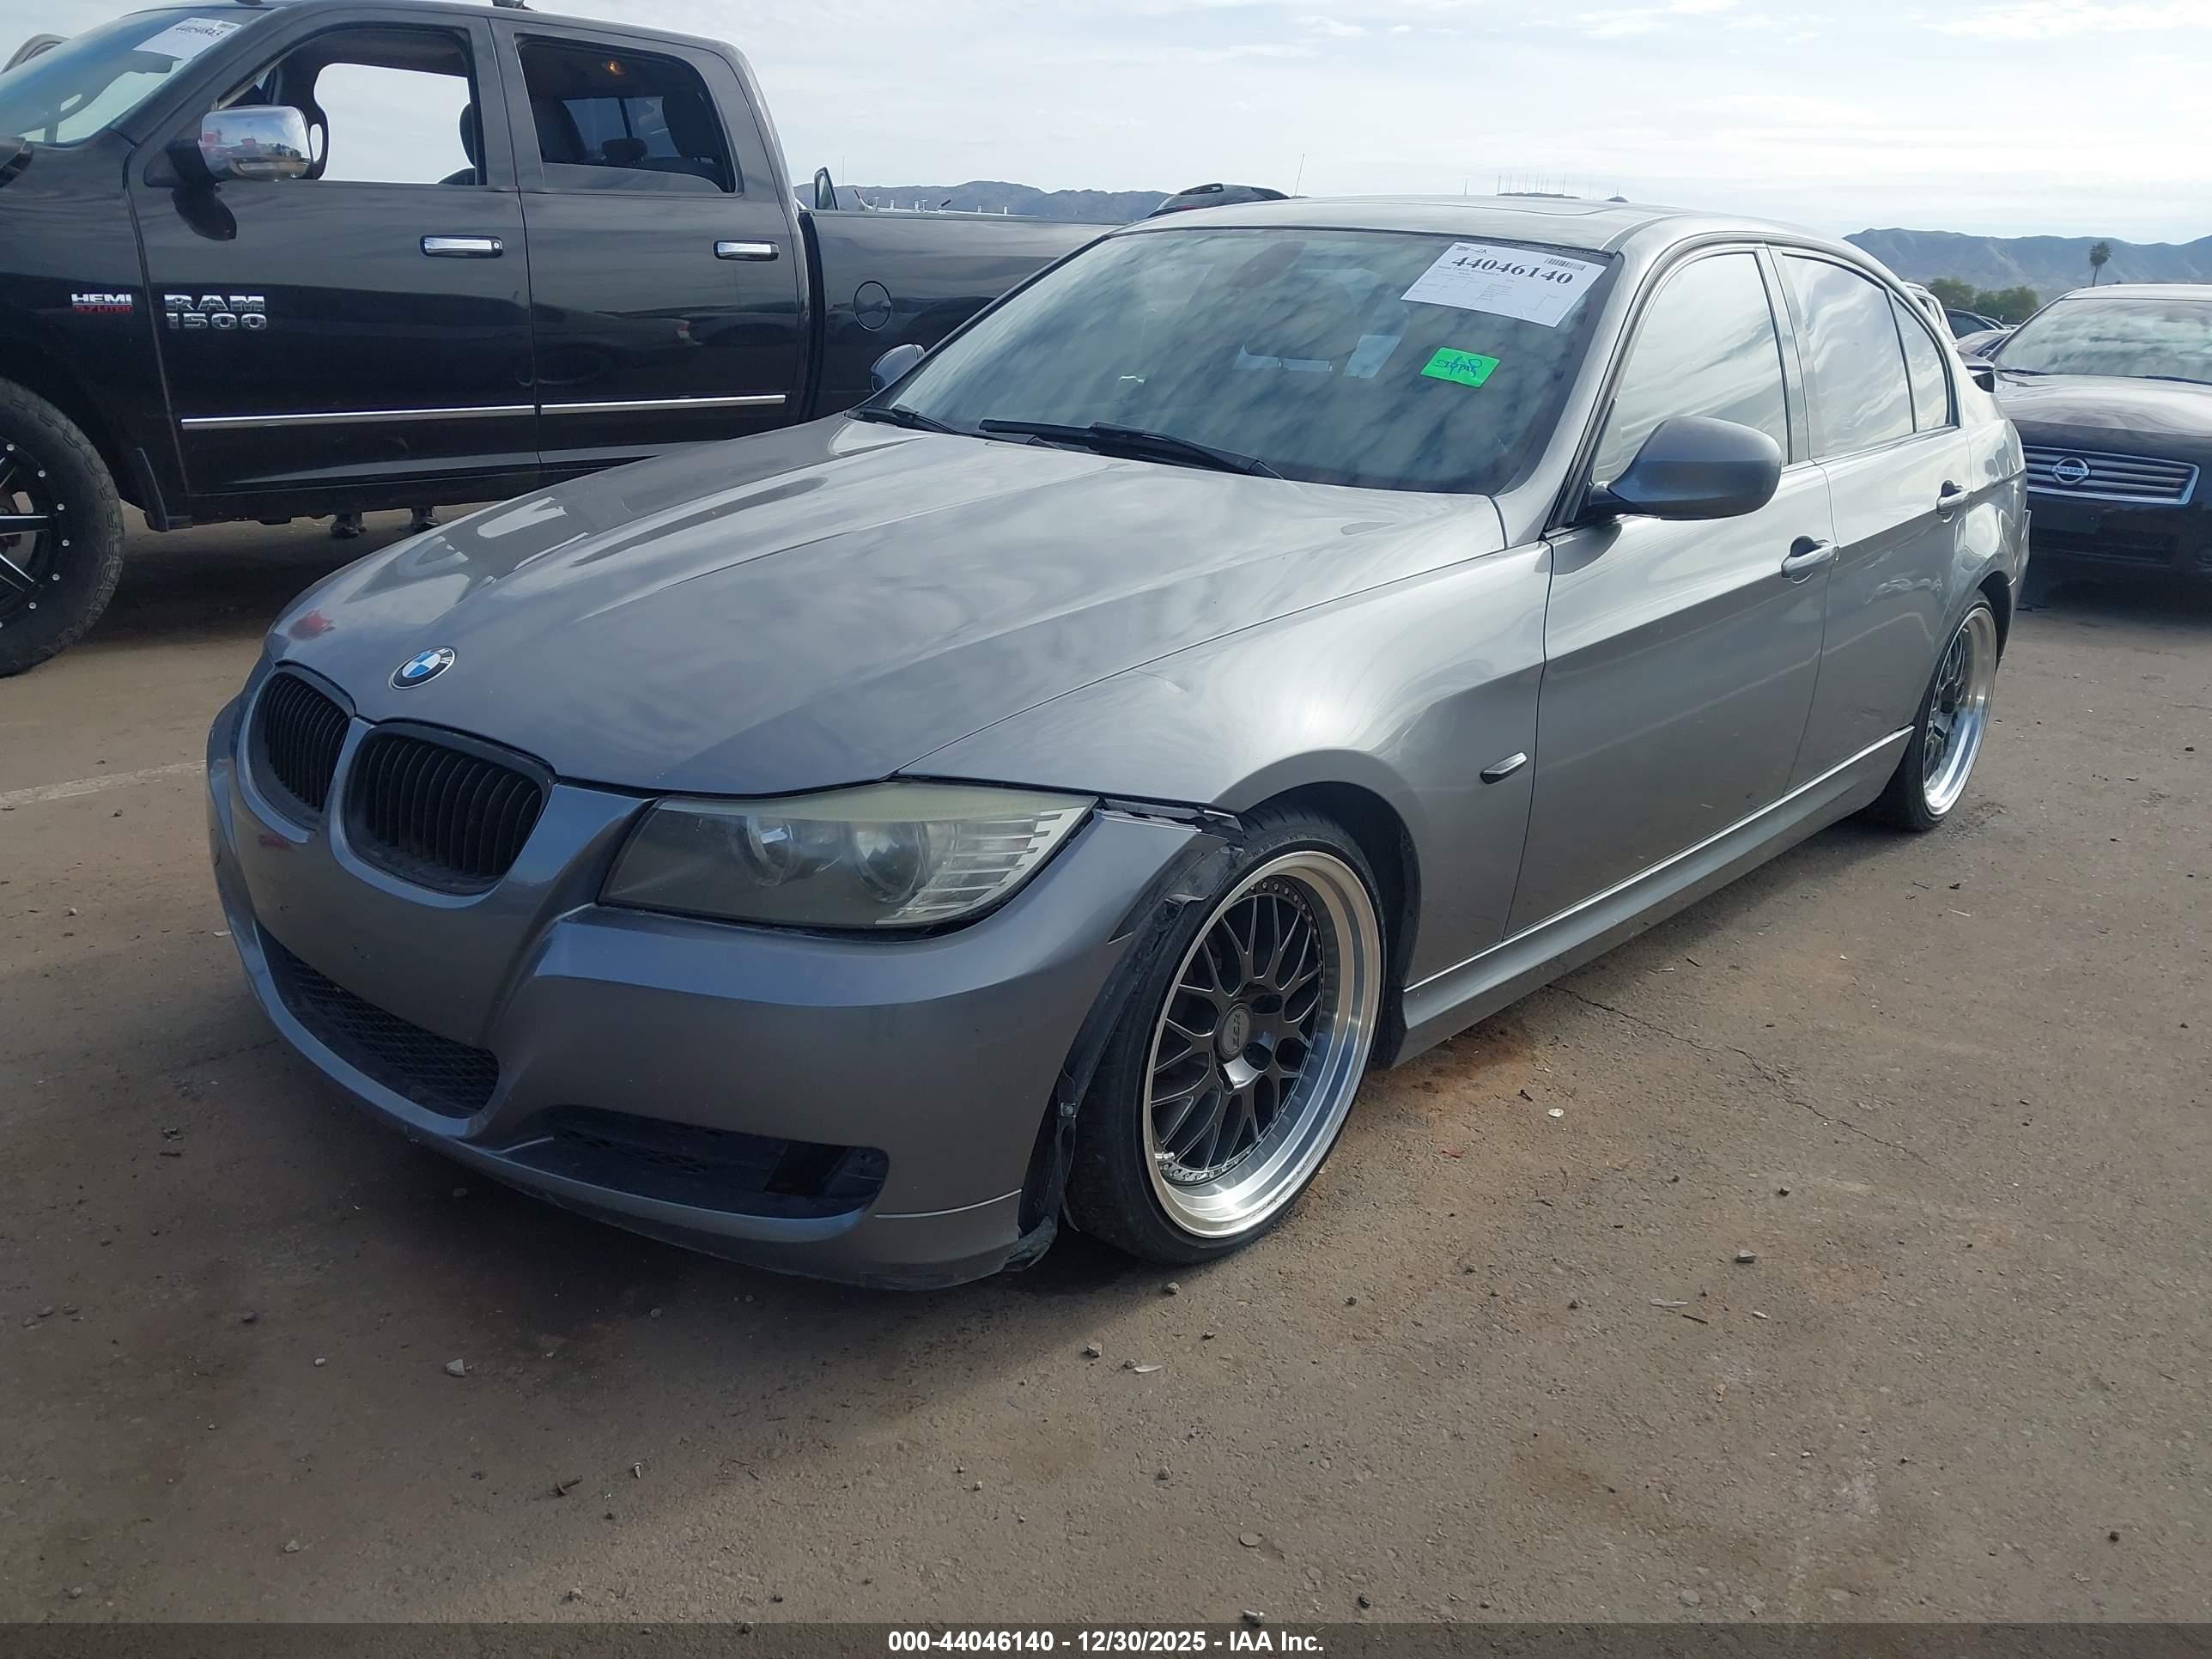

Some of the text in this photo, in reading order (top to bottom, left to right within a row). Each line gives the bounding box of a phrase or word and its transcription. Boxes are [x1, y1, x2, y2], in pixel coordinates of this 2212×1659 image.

[1452, 257, 1574, 284] 44046140
[70, 294, 132, 303] HEMI
[164, 295, 265, 311] RAM
[166, 313, 267, 330] 1500
[2056, 466, 2086, 475] NISSAN
